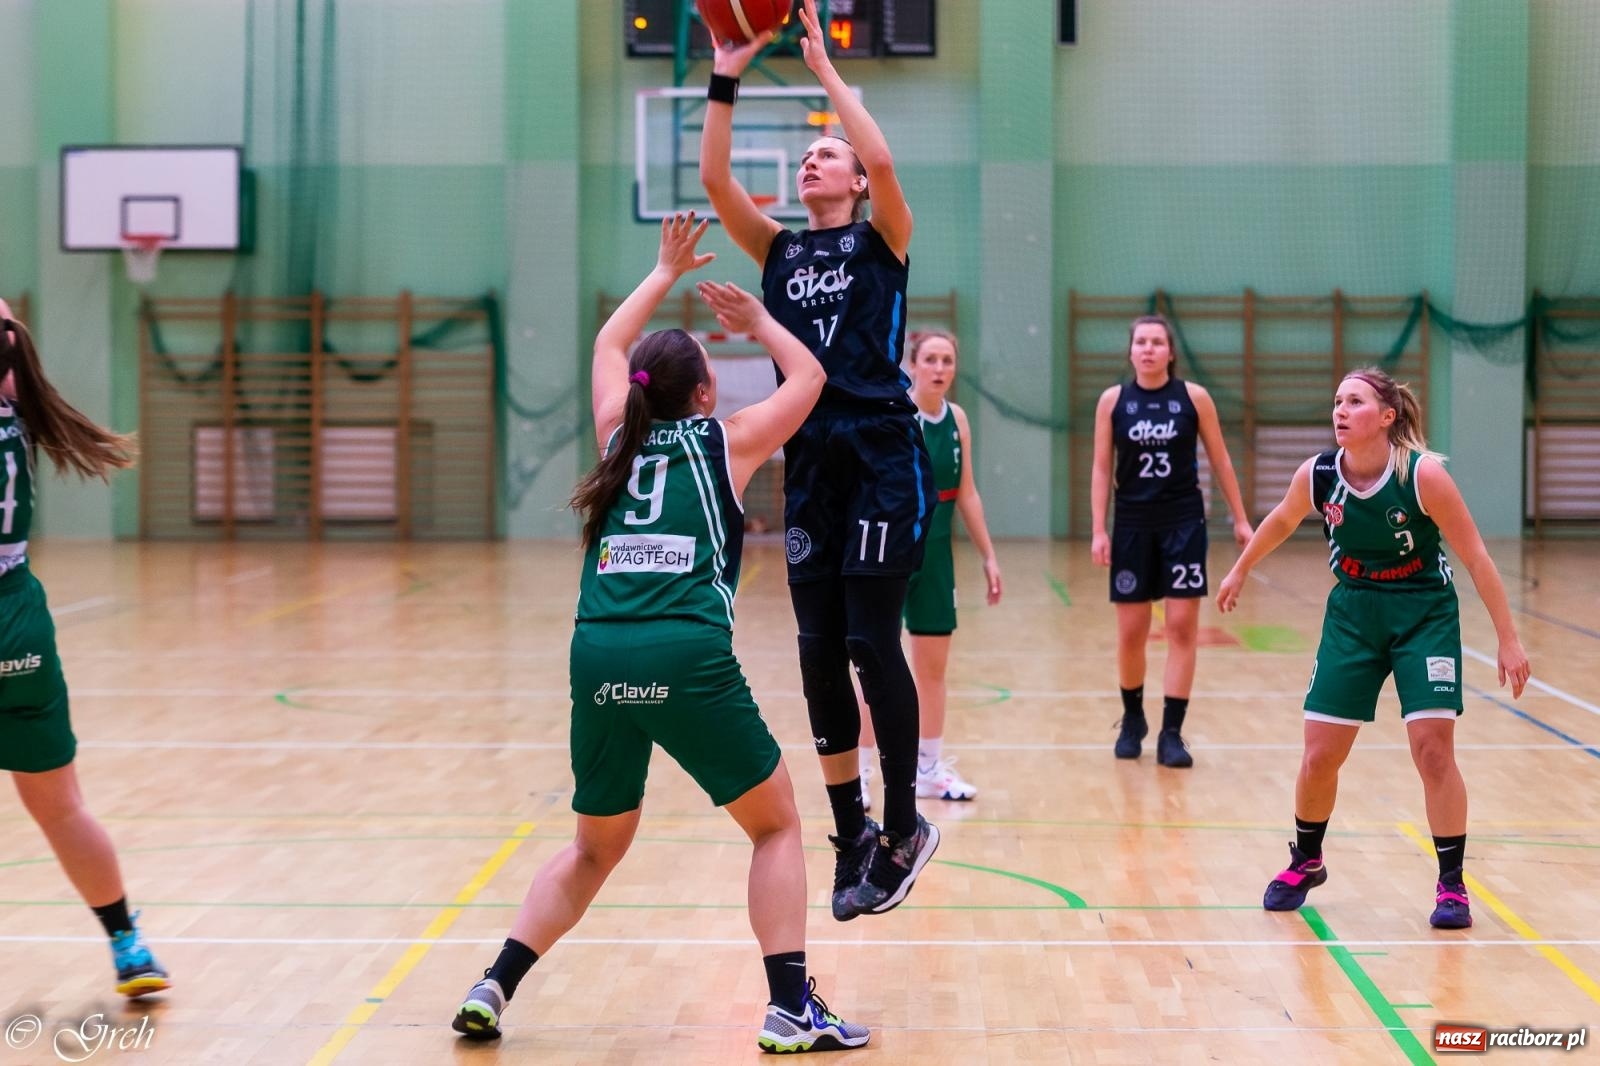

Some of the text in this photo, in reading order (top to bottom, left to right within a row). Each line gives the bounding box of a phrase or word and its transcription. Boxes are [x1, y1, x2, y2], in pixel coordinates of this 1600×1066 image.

[801, 292, 844, 308] BRZEG
[812, 314, 839, 347] 11
[1139, 452, 1172, 478] 23
[624, 453, 669, 526] 9
[610, 543, 663, 552] wydawnictwo
[858, 519, 889, 563] 11
[1395, 529, 1415, 556] 3
[609, 551, 690, 567] WAGTECH
[1171, 562, 1205, 590] 23
[611, 682, 670, 700] Clavis
